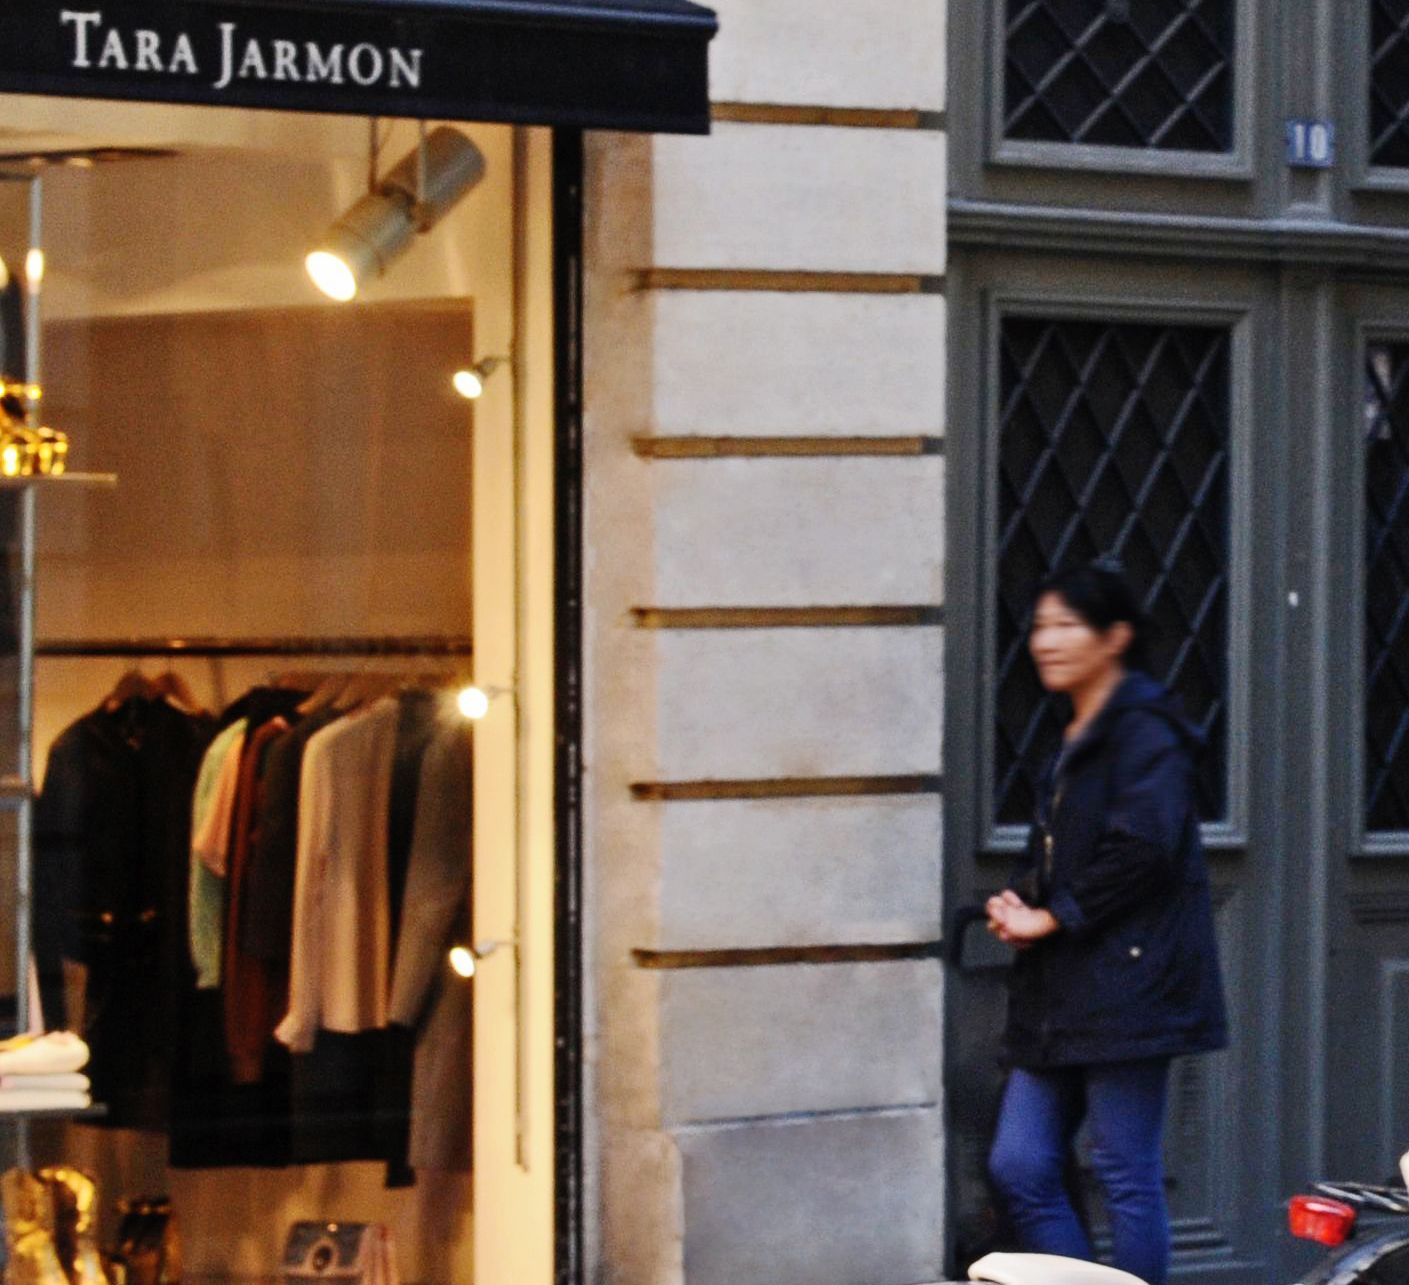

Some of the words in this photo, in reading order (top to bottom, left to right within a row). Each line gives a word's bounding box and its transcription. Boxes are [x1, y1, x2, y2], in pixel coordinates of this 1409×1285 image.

[60, 10, 198, 74] TARA
[212, 22, 423, 88] JARMON
[1295, 123, 1328, 160] 10
